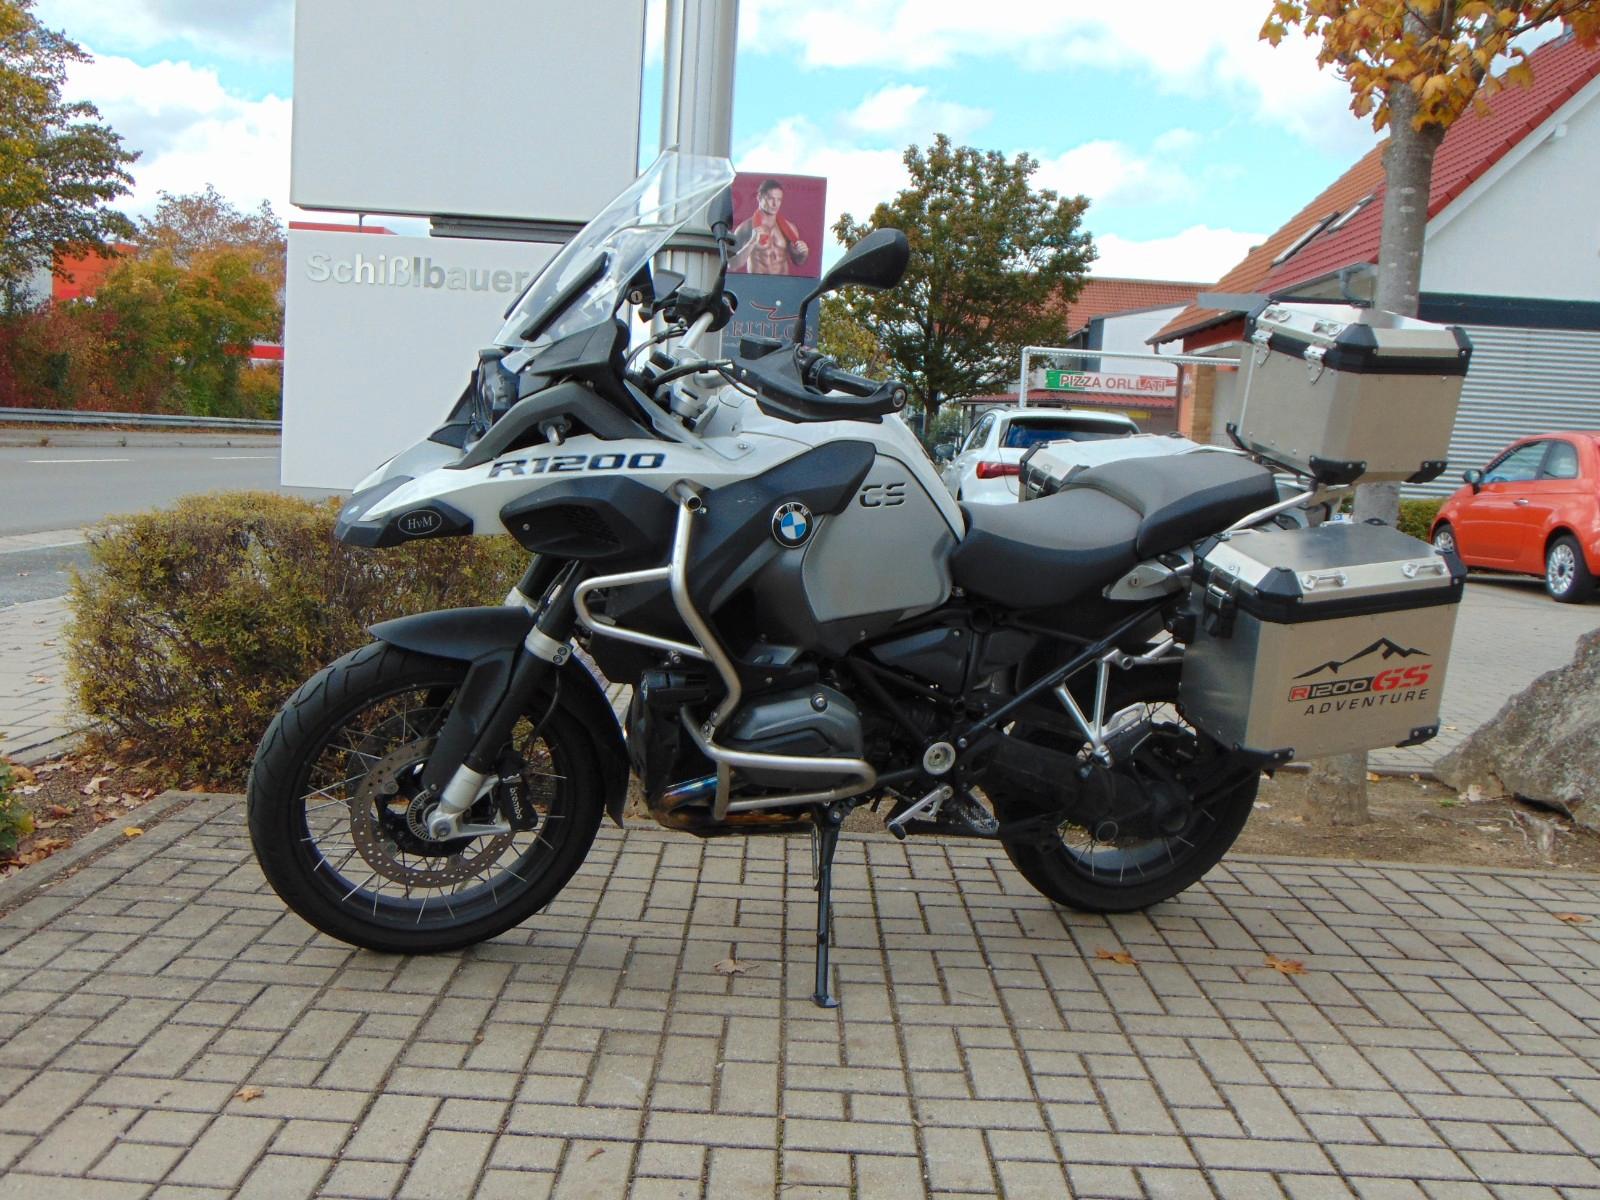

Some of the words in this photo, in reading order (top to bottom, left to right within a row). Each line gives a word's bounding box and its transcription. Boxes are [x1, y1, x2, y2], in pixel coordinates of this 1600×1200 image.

[304, 250, 532, 294] Schißlbauer
[1059, 373, 1102, 389] PIZZA
[487, 453, 666, 479] R1200
[859, 482, 906, 508] GS
[407, 515, 434, 530] HvM
[774, 503, 811, 521] BMW
[1304, 688, 1430, 716] ADVENTURE
[509, 787, 524, 820] brembo
